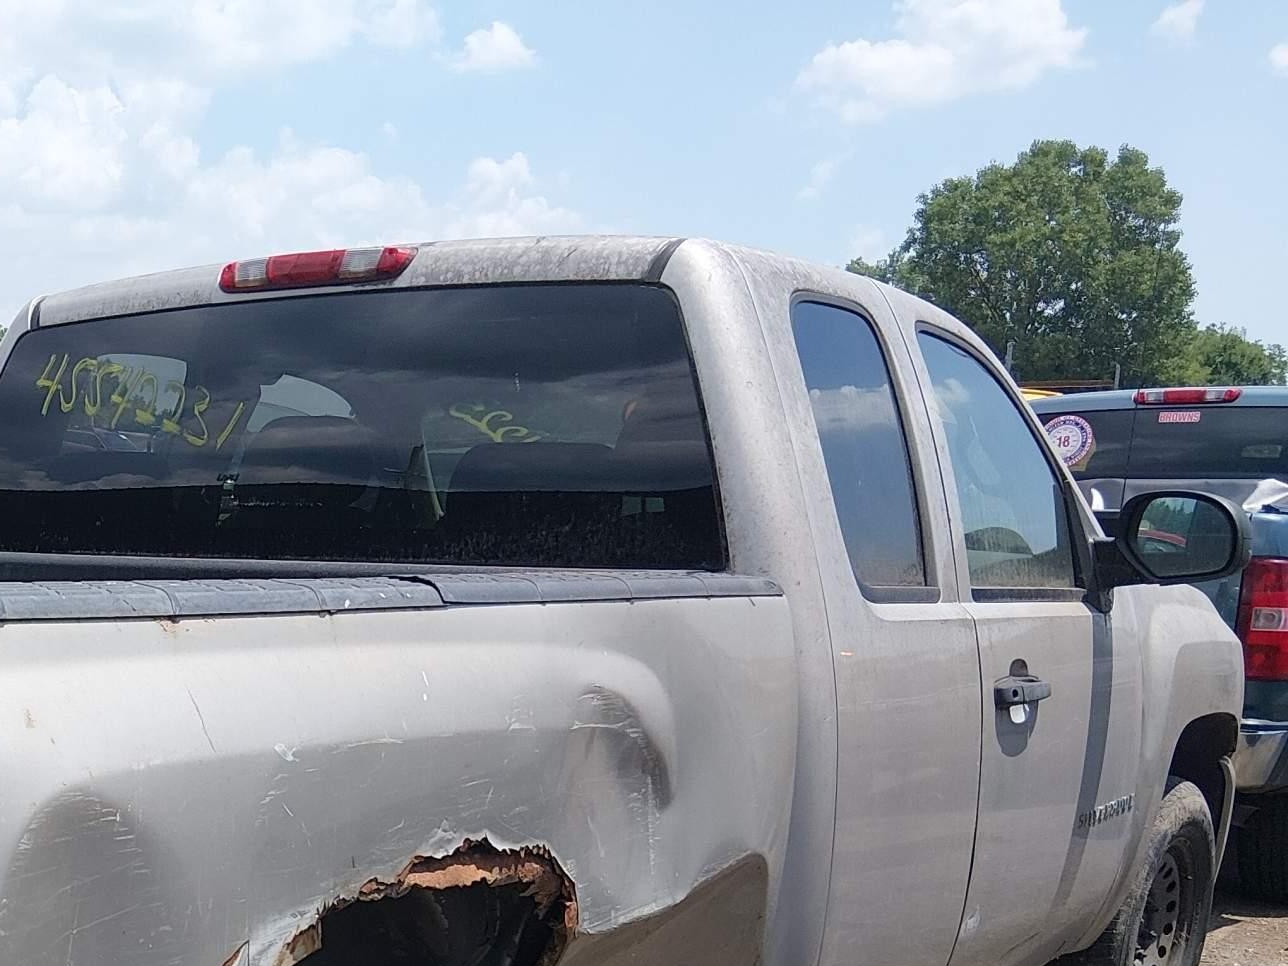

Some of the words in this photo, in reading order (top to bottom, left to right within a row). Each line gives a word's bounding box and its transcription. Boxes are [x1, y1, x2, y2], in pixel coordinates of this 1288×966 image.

[36, 353, 245, 451] 45542231
[1159, 411, 1200, 422] BROWNS
[1056, 435, 1070, 448] 18
